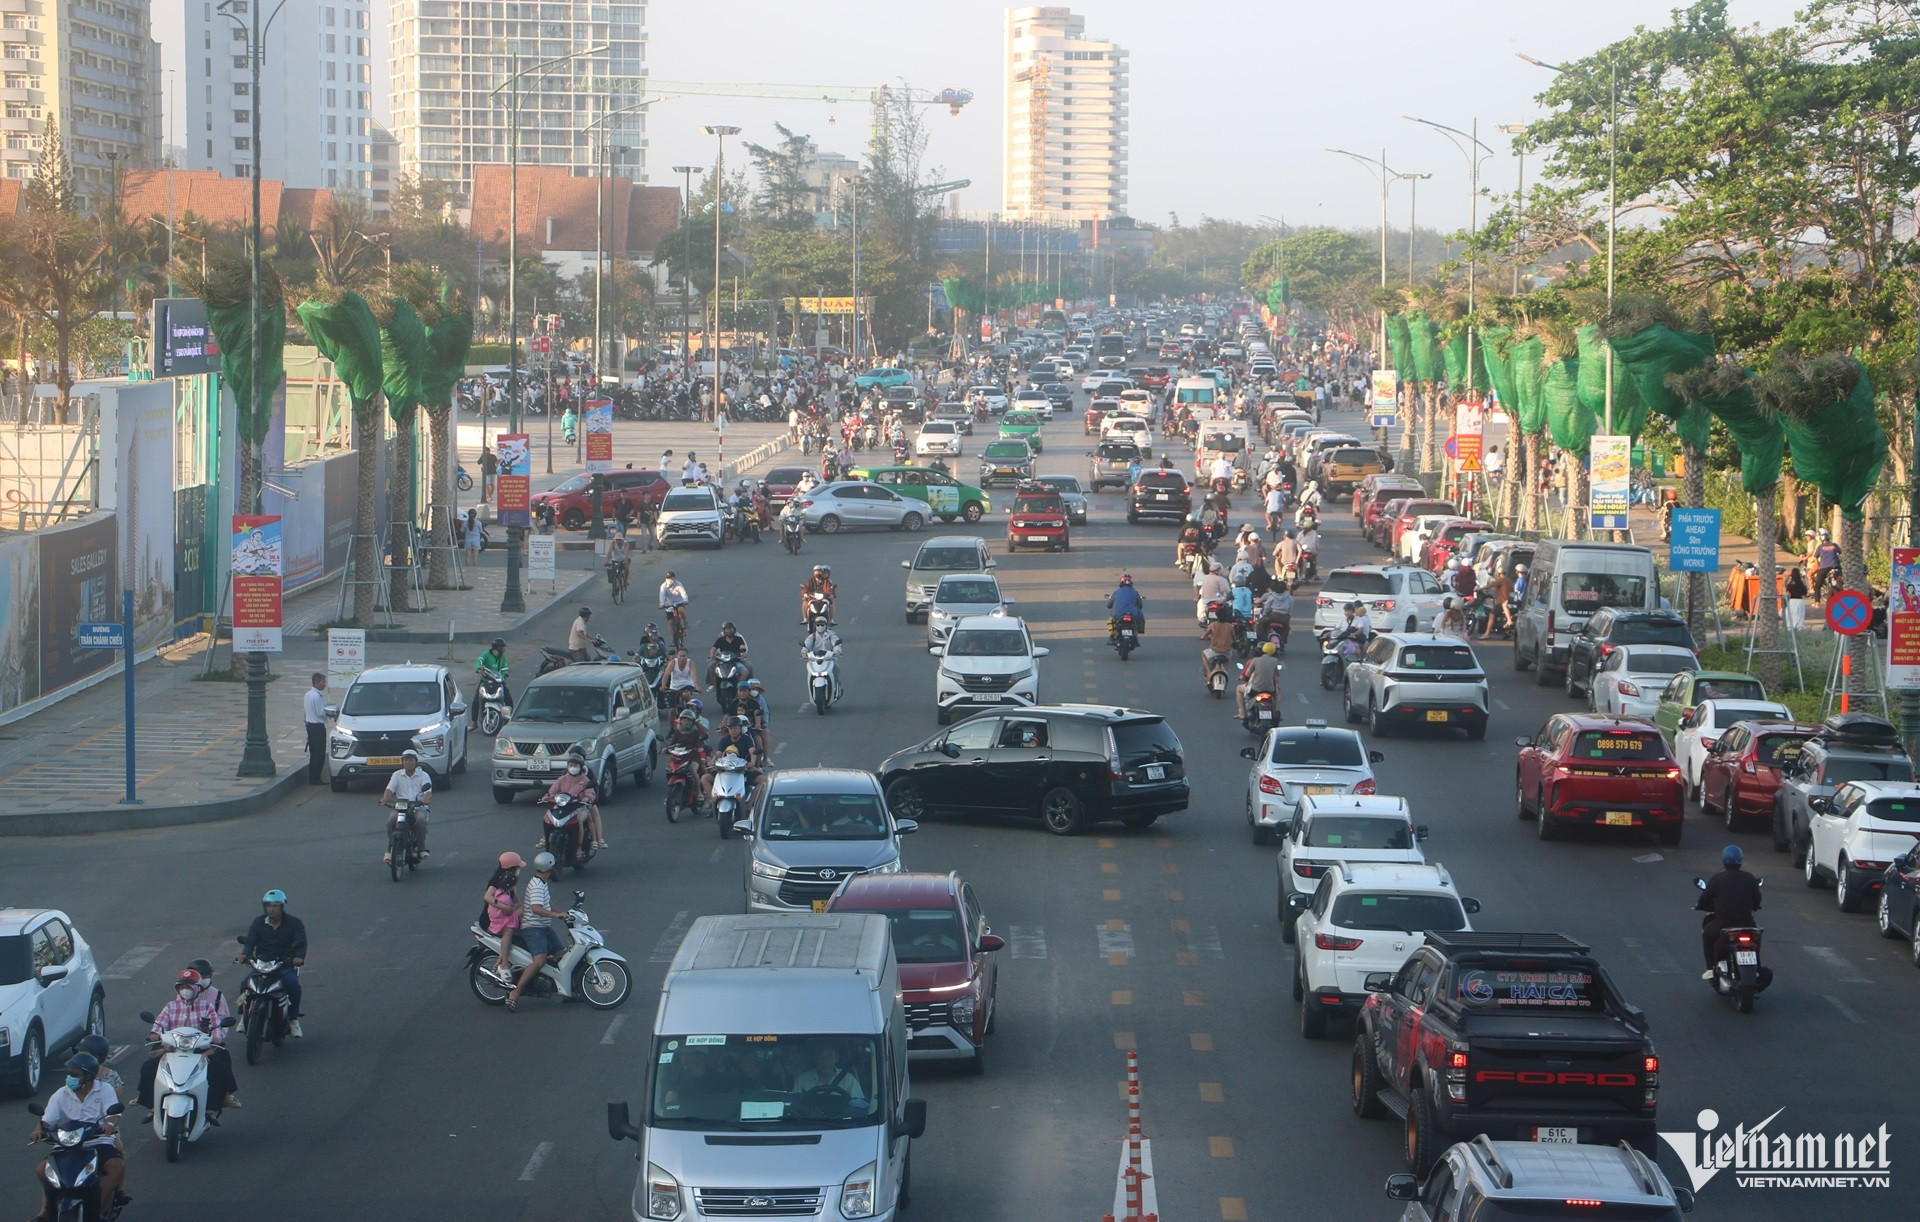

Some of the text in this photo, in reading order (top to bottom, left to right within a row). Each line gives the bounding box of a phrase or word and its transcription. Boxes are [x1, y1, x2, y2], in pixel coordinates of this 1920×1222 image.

[1679, 513, 1713, 523] PHÍA TRƯỚC
[1689, 536, 1701, 544] 50m
[1673, 545, 1716, 555] CÔNG TRƯỜNG
[71, 548, 107, 575] SALES GALLERY
[1683, 559, 1704, 567] WORKS
[81, 633, 122, 644] TRẦN CHÁNH CHIẾU
[1597, 740, 1642, 750] 0898 579 679
[1497, 972, 1591, 983] CTY TNHH HẢI SẢN
[1511, 983, 1577, 999] HẢI CÁ
[1475, 1071, 1636, 1086] FORD
[1548, 1129, 1566, 1137] 61C
[750, 1198, 769, 1206] Ford
